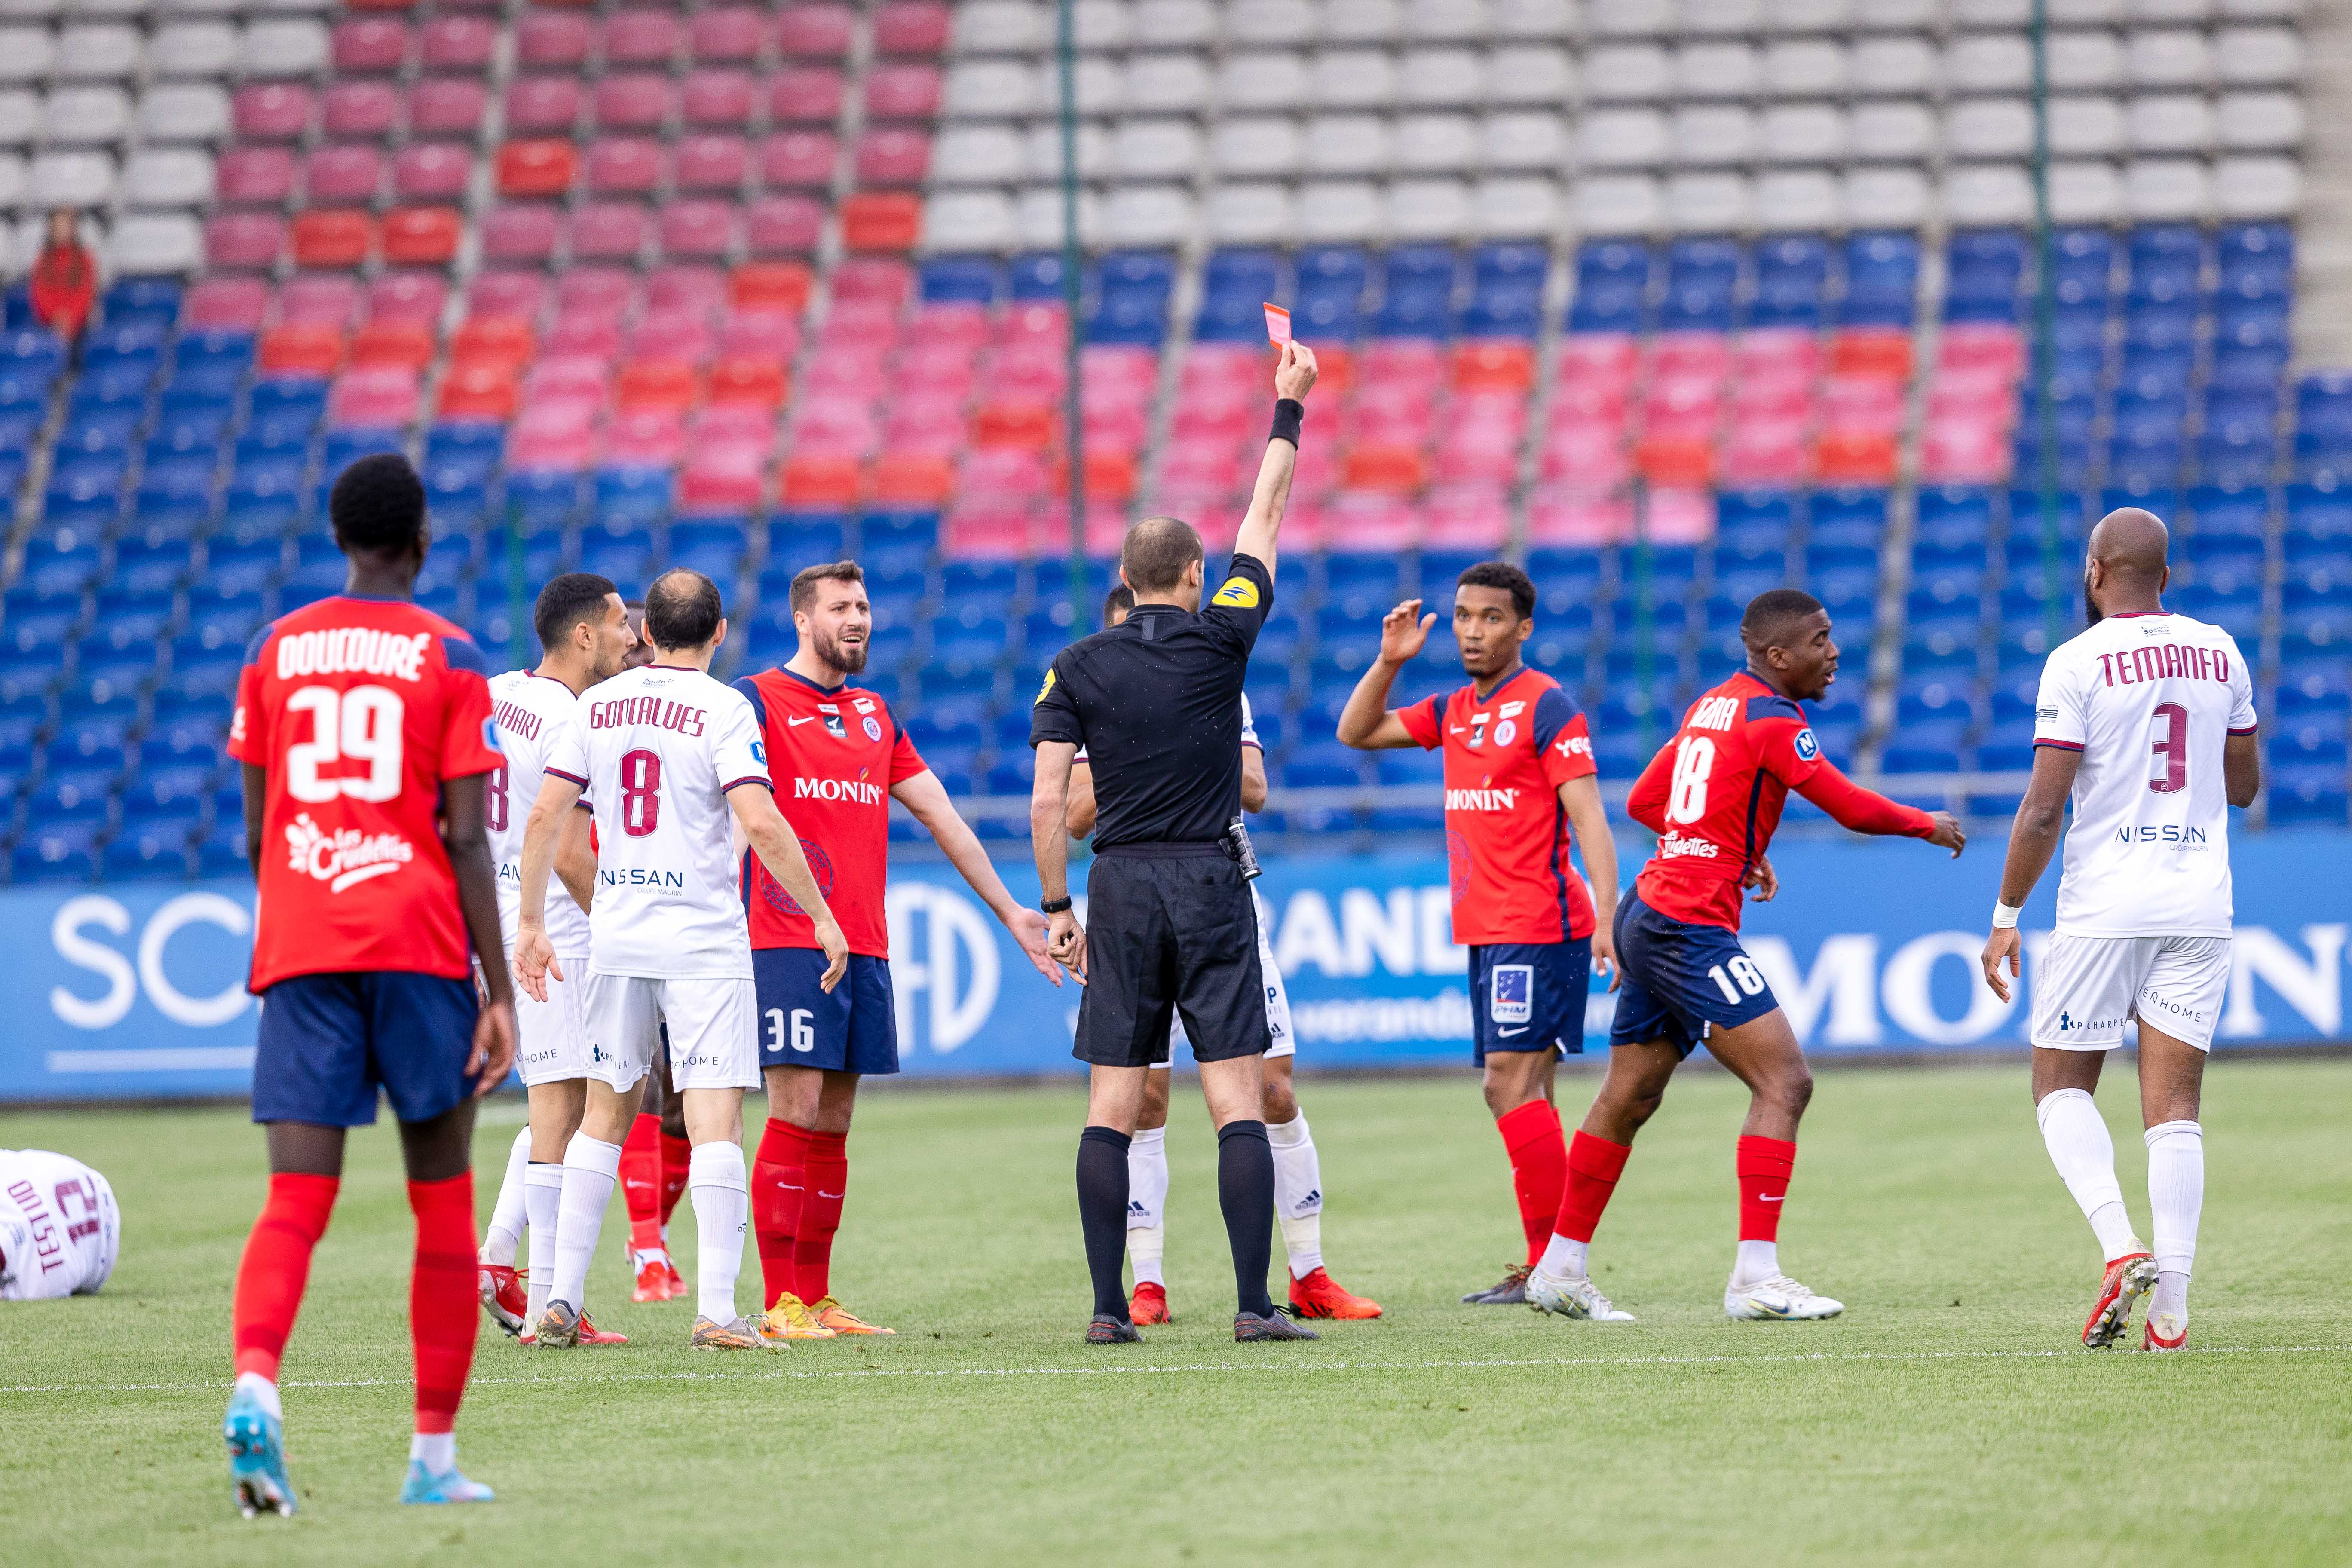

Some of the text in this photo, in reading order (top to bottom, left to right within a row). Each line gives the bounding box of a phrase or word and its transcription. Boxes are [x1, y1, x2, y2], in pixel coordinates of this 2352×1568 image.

[277, 628, 431, 682] DOUCOURÉ
[2096, 644, 2228, 687] TEMANFO
[590, 696, 707, 737] GONCALVES
[286, 685, 404, 803] 29
[2148, 701, 2189, 794] 3
[619, 747, 662, 839] 8
[794, 777, 880, 806] MONIN
[1445, 788, 1515, 811] MONIN
[1665, 735, 1715, 824] 18
[2115, 825, 2206, 843] NISSAN
[1708, 955, 1766, 1005] 18
[764, 1008, 815, 1052] 36
[55, 1175, 101, 1246] 12
